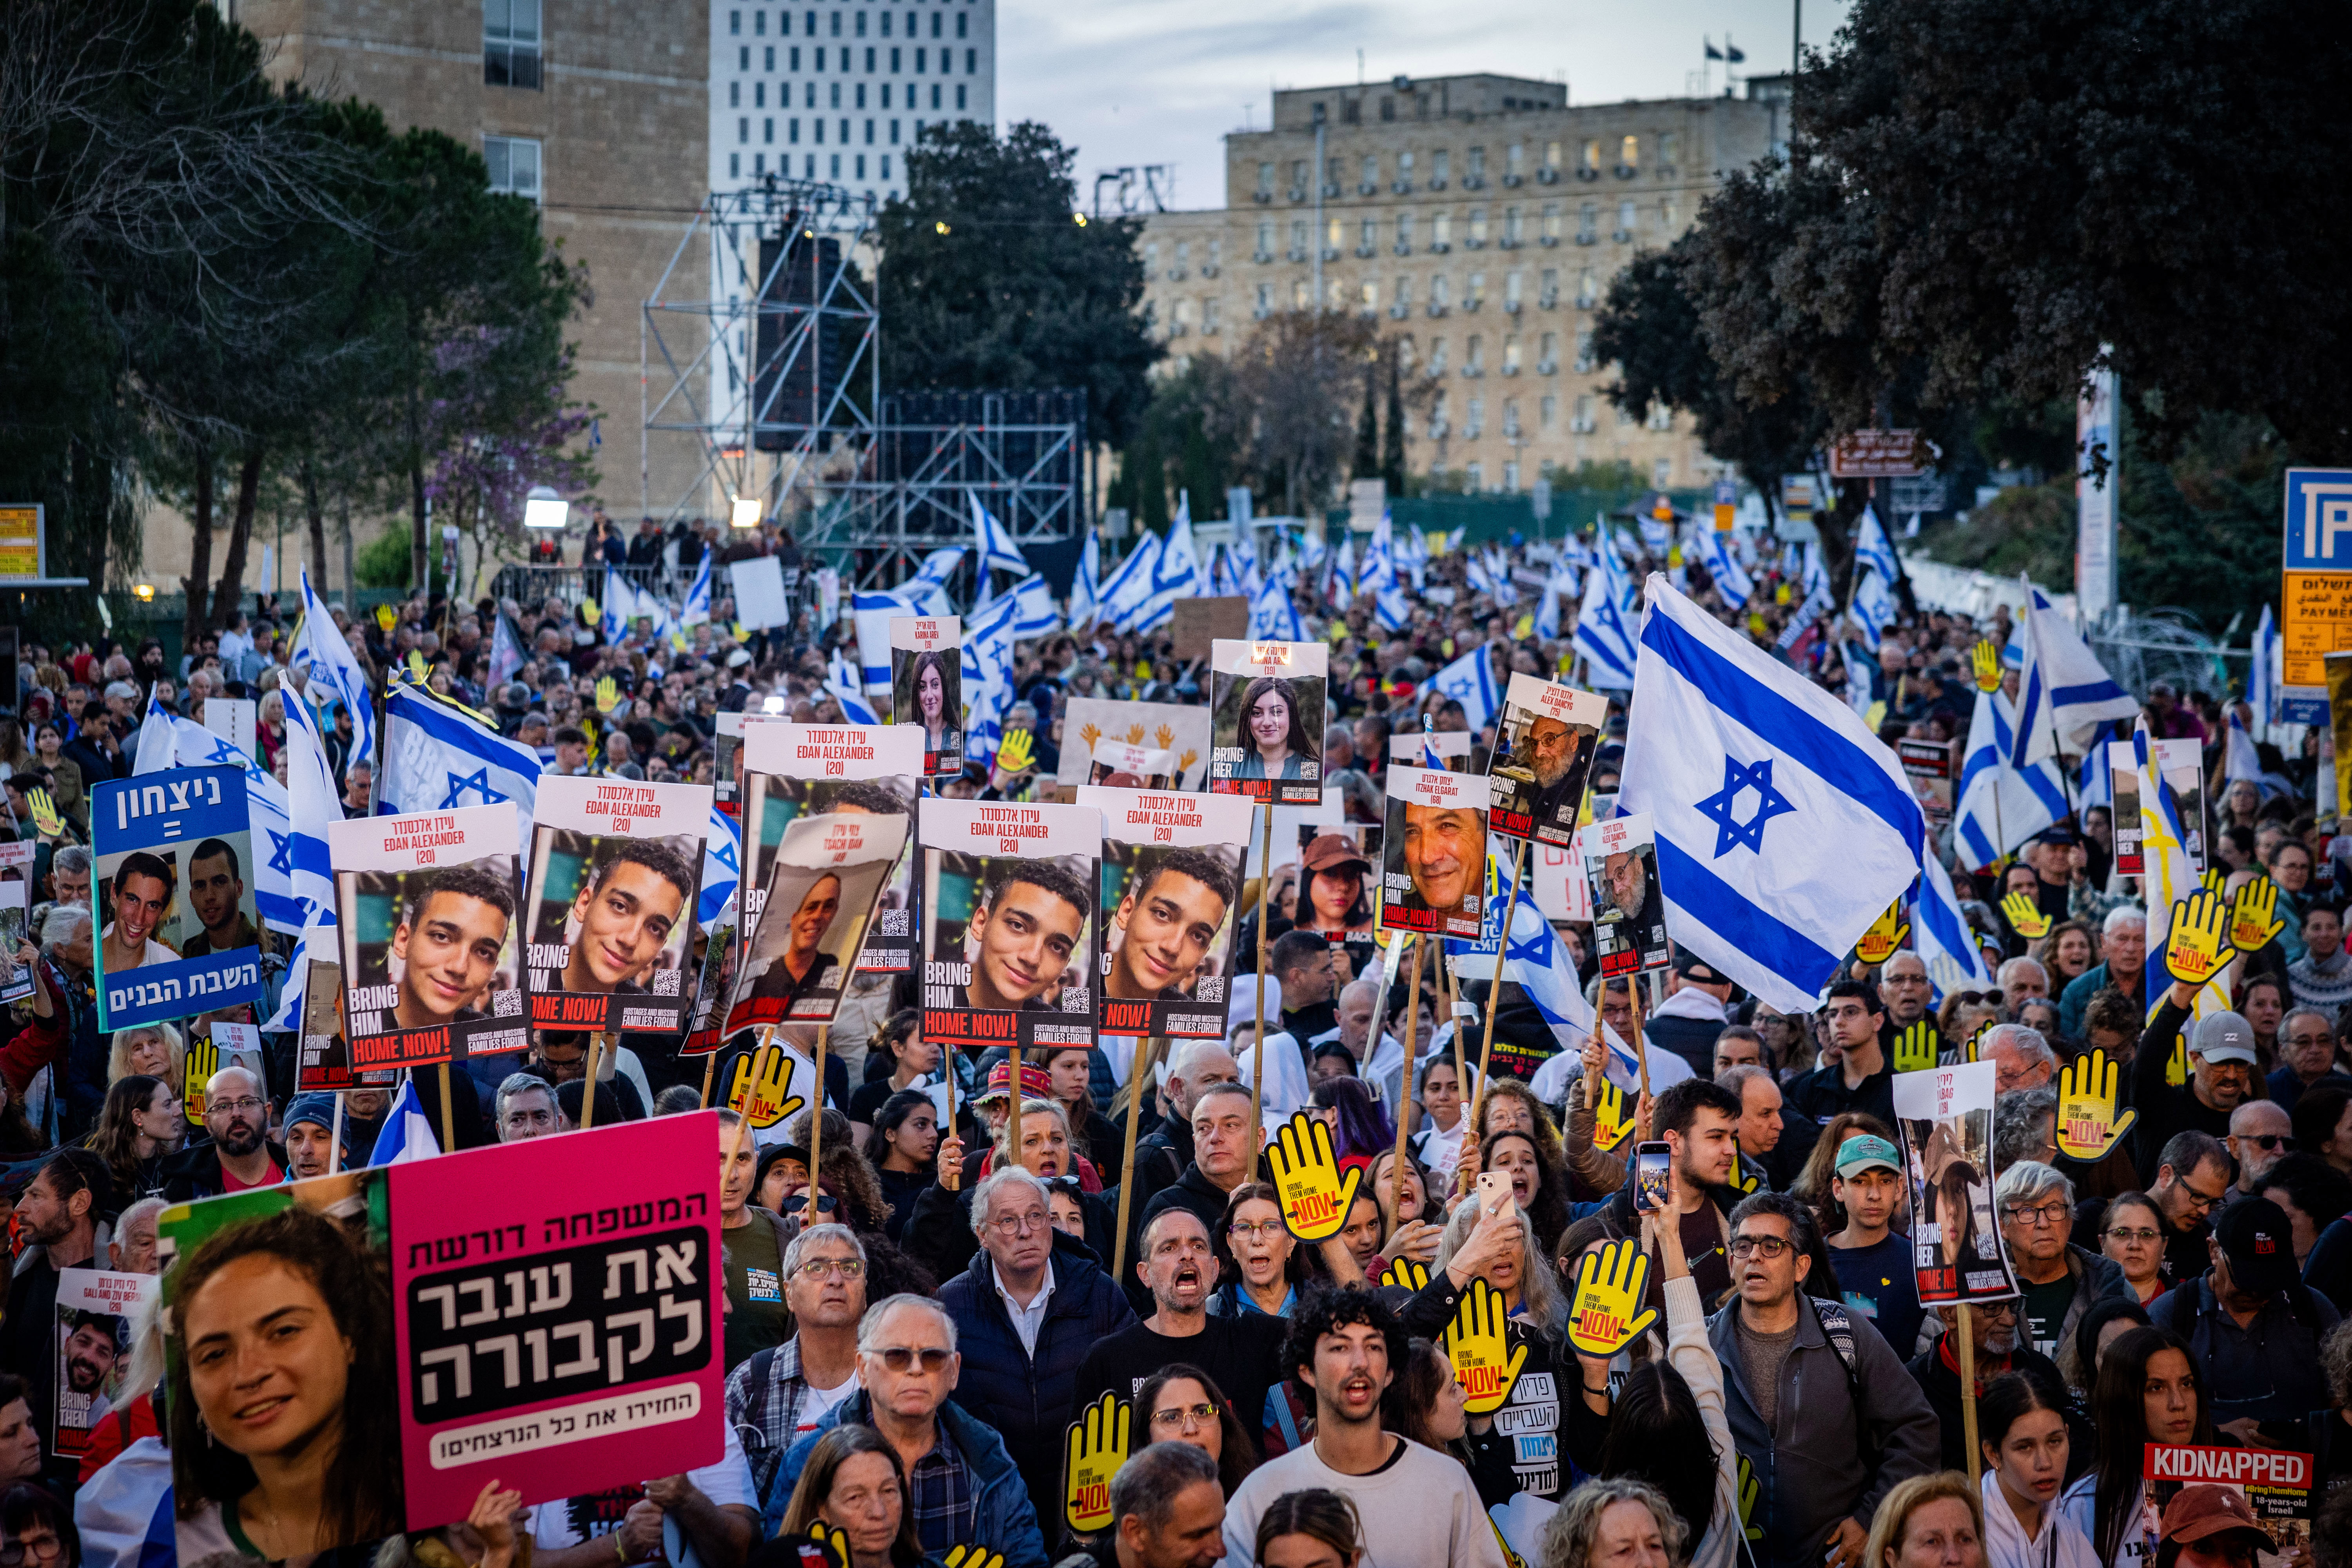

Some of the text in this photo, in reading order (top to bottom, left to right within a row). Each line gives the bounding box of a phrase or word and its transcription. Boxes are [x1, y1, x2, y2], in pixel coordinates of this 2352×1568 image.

[915, 631, 929, 639] KARINA
[1271, 647, 1287, 655] קרינה
[1265, 666, 1275, 675] (19)
[1546, 686, 1573, 700] אלכס דנציג
[1540, 695, 1573, 710] ALEX DANCYG
[1550, 707, 1561, 717] (75)
[806, 730, 866, 745] עידן אלכסנדר
[797, 745, 874, 760] EDAN ALEXANDER
[1214, 747, 1243, 762] BRING
[826, 761, 844, 775] (20)
[1213, 763, 1232, 778] HER
[1213, 780, 1272, 796] HOME NOW!
[1422, 774, 1453, 786] יצחק אלגרט
[597, 786, 655, 802] עידן אלכסנדר
[1416, 783, 1458, 796] ITZHAK ELGARAT
[117, 777, 221, 829] ניצחון
[1138, 795, 1196, 812] עידן אלכסנדר
[1430, 795, 1441, 805] (68)
[586, 801, 661, 818] EDAN ALEXANDER
[979, 807, 1040, 823] עידן אלכסנדר
[392, 816, 455, 835] עידן אלכסנדר
[613, 818, 630, 833] (20)
[1127, 810, 1202, 828] EDAN ALEXANDER
[1505, 812, 1532, 832] NOW!
[971, 822, 1049, 839] EDAN ALEXANDER
[1154, 827, 1172, 842] (20)
[1537, 830, 1568, 844] FAMILIES FORUM
[1602, 831, 1626, 844] ALEX DANCYG
[385, 831, 465, 852] EDAN ALEXANDER
[1000, 838, 1018, 854] (20)
[416, 850, 435, 865] (20)
[1385, 872, 1411, 890] BRING
[1385, 888, 1401, 905] HIM
[1385, 905, 1437, 927] HOME NOW!
[1447, 923, 1479, 935] FAMILIES FORUM
[1597, 924, 1614, 941] BRING
[1599, 940, 1610, 955] HIM
[526, 944, 569, 969] BRING
[2173, 946, 2211, 971] NOW
[924, 961, 972, 987] BRING
[110, 963, 258, 1013] השבת הבנים
[348, 984, 398, 1012] BRING
[924, 985, 954, 1009] HIM
[562, 996, 608, 1022] NOW!
[624, 1007, 647, 1016] HOSTAGES
[658, 1009, 678, 1018] MISSING
[1107, 1002, 1152, 1028] NOW!
[350, 1010, 383, 1037] HIM
[622, 1014, 678, 1028] FAMILIES FORUM
[925, 1011, 1017, 1038] HOME NOW!
[1034, 1024, 1091, 1034] HOSTAGES AND MISSING
[1166, 1020, 1221, 1034] FAMILIES FORUM
[304, 1034, 330, 1050] BRING
[468, 1028, 526, 1043] HOSTAGES AND MISSING
[1034, 1032, 1092, 1045] FAMILIES FORUM
[353, 1026, 451, 1063] HOME NOW!
[468, 1034, 527, 1054] FAMILIES FORUM
[1494, 1043, 1517, 1053] כולם
[303, 1050, 320, 1066] HIM
[302, 1067, 327, 1082] HOME
[2065, 1120, 2108, 1143] NOW
[1287, 1181, 1303, 1192] BRING
[1289, 1186, 1318, 1200] THEM HOME
[1291, 1190, 1338, 1224] NOW
[408, 1193, 706, 1269] המשפחה דורשת
[1916, 1222, 1942, 1246] BRING
[1916, 1245, 1933, 1268] HER
[418, 1240, 698, 1331] את ענבר
[1968, 1276, 2005, 1291] FAMILIES FORUM
[83, 1288, 122, 1301] GALI AND ZIV
[749, 1287, 773, 1298] לנשק
[1585, 1293, 1601, 1303] BRING
[1583, 1301, 1612, 1314] THEM HOME
[1577, 1309, 1626, 1339] NOW
[420, 1294, 703, 1405] לקבורה
[1458, 1350, 1472, 1359] BRING
[1459, 1357, 1486, 1368] THEM HOME
[1459, 1365, 1502, 1394] NOW
[1517, 1376, 1549, 1401] פדיון
[60, 1391, 91, 1410] BRING
[627, 1393, 692, 1419] החזירו
[59, 1410, 88, 1428] THEM
[551, 1417, 575, 1435] כל
[586, 1409, 616, 1428] את
[1502, 1405, 1557, 1431] השבויים
[1519, 1436, 1556, 1460] ניצחון
[2154, 1447, 2304, 1483] KIDNAPPED
[2245, 1485, 2307, 1497] #BringThemHome
[2256, 1496, 2307, 1508] 18-years-old
[2268, 1506, 2293, 1515] Israeli
